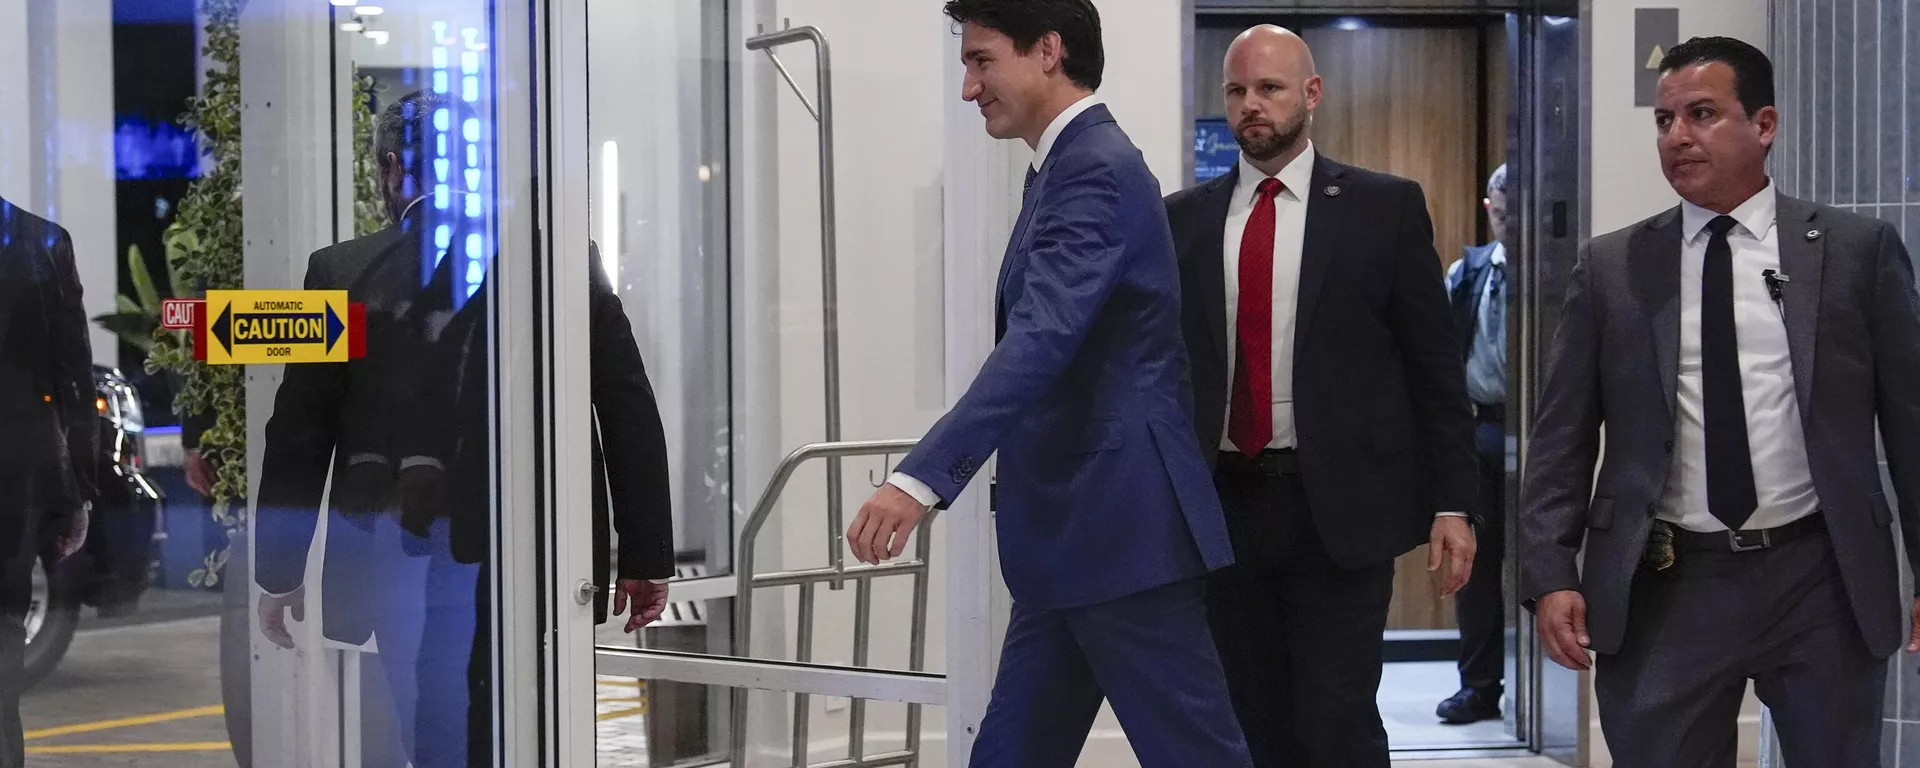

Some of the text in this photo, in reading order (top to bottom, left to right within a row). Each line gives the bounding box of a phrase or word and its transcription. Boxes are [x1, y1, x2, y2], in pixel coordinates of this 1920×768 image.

[253, 301, 303, 310] AUTOMATIC
[234, 318, 322, 340] CAUTION
[267, 347, 291, 356] DOOR
